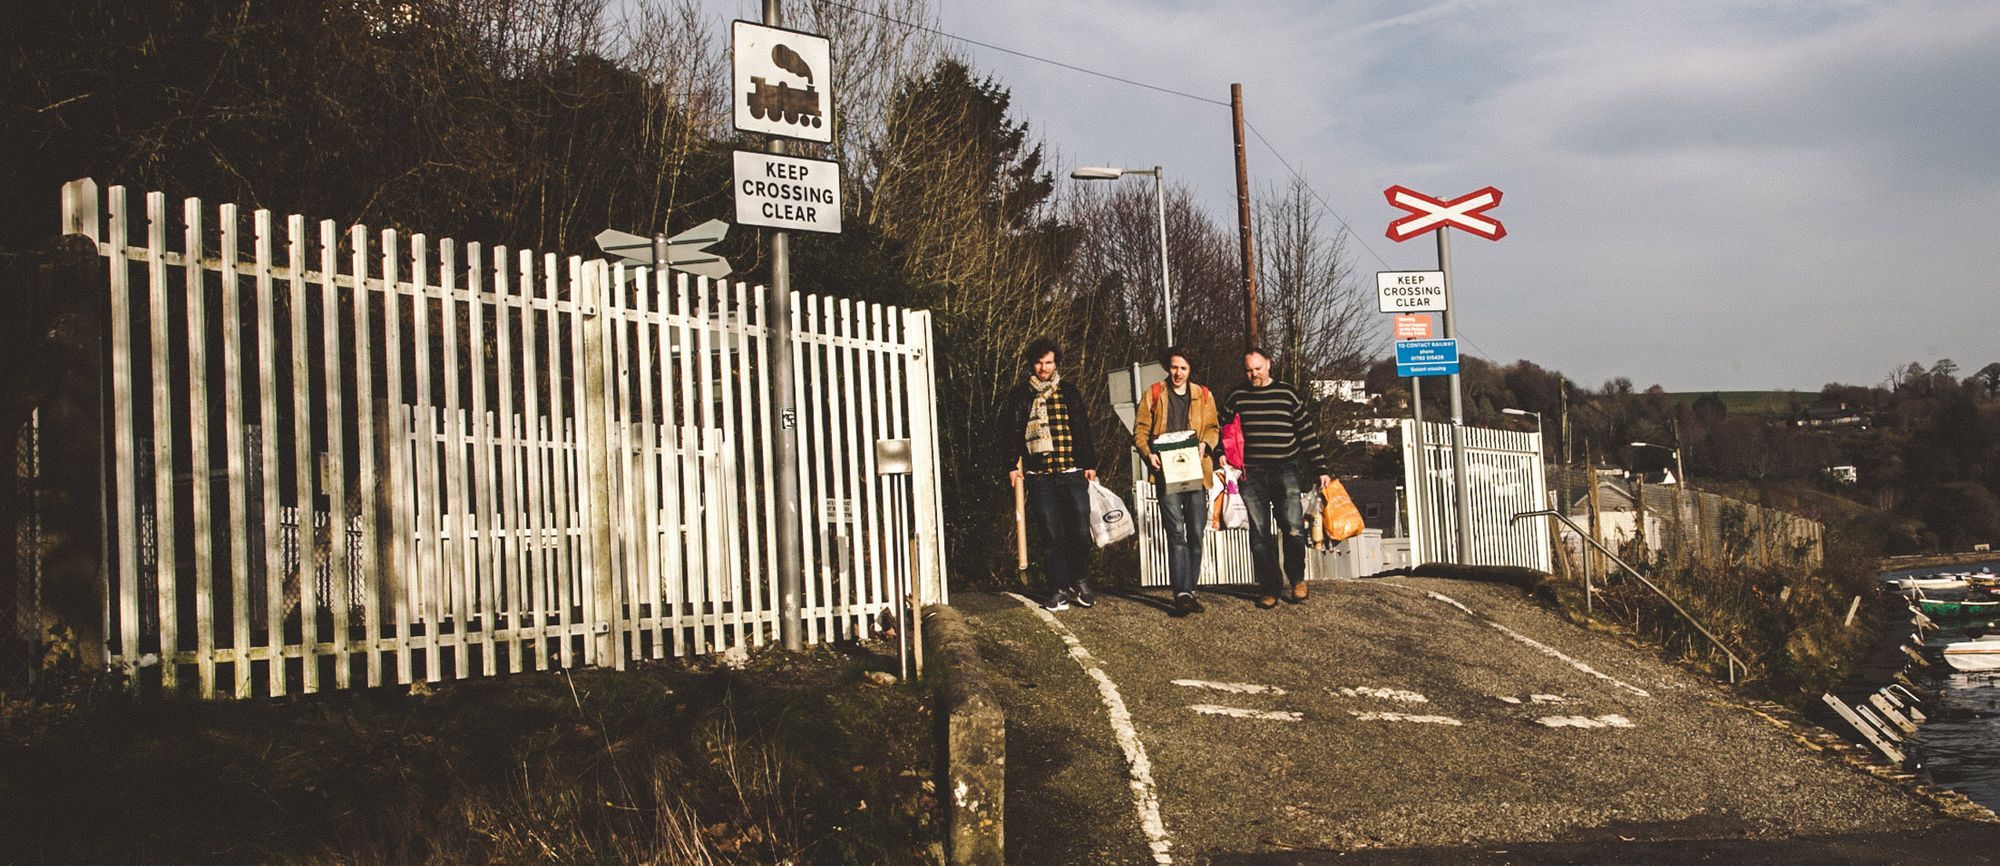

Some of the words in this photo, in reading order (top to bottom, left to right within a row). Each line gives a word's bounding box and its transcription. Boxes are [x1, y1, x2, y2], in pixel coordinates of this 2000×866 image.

[766, 161, 809, 181] KEEP
[742, 179, 834, 205] CROSSING
[762, 202, 817, 223] CLEAR
[1397, 275, 1425, 285] KEEP
[1383, 286, 1441, 297] CROSSING
[1395, 297, 1431, 307] CLEAR
